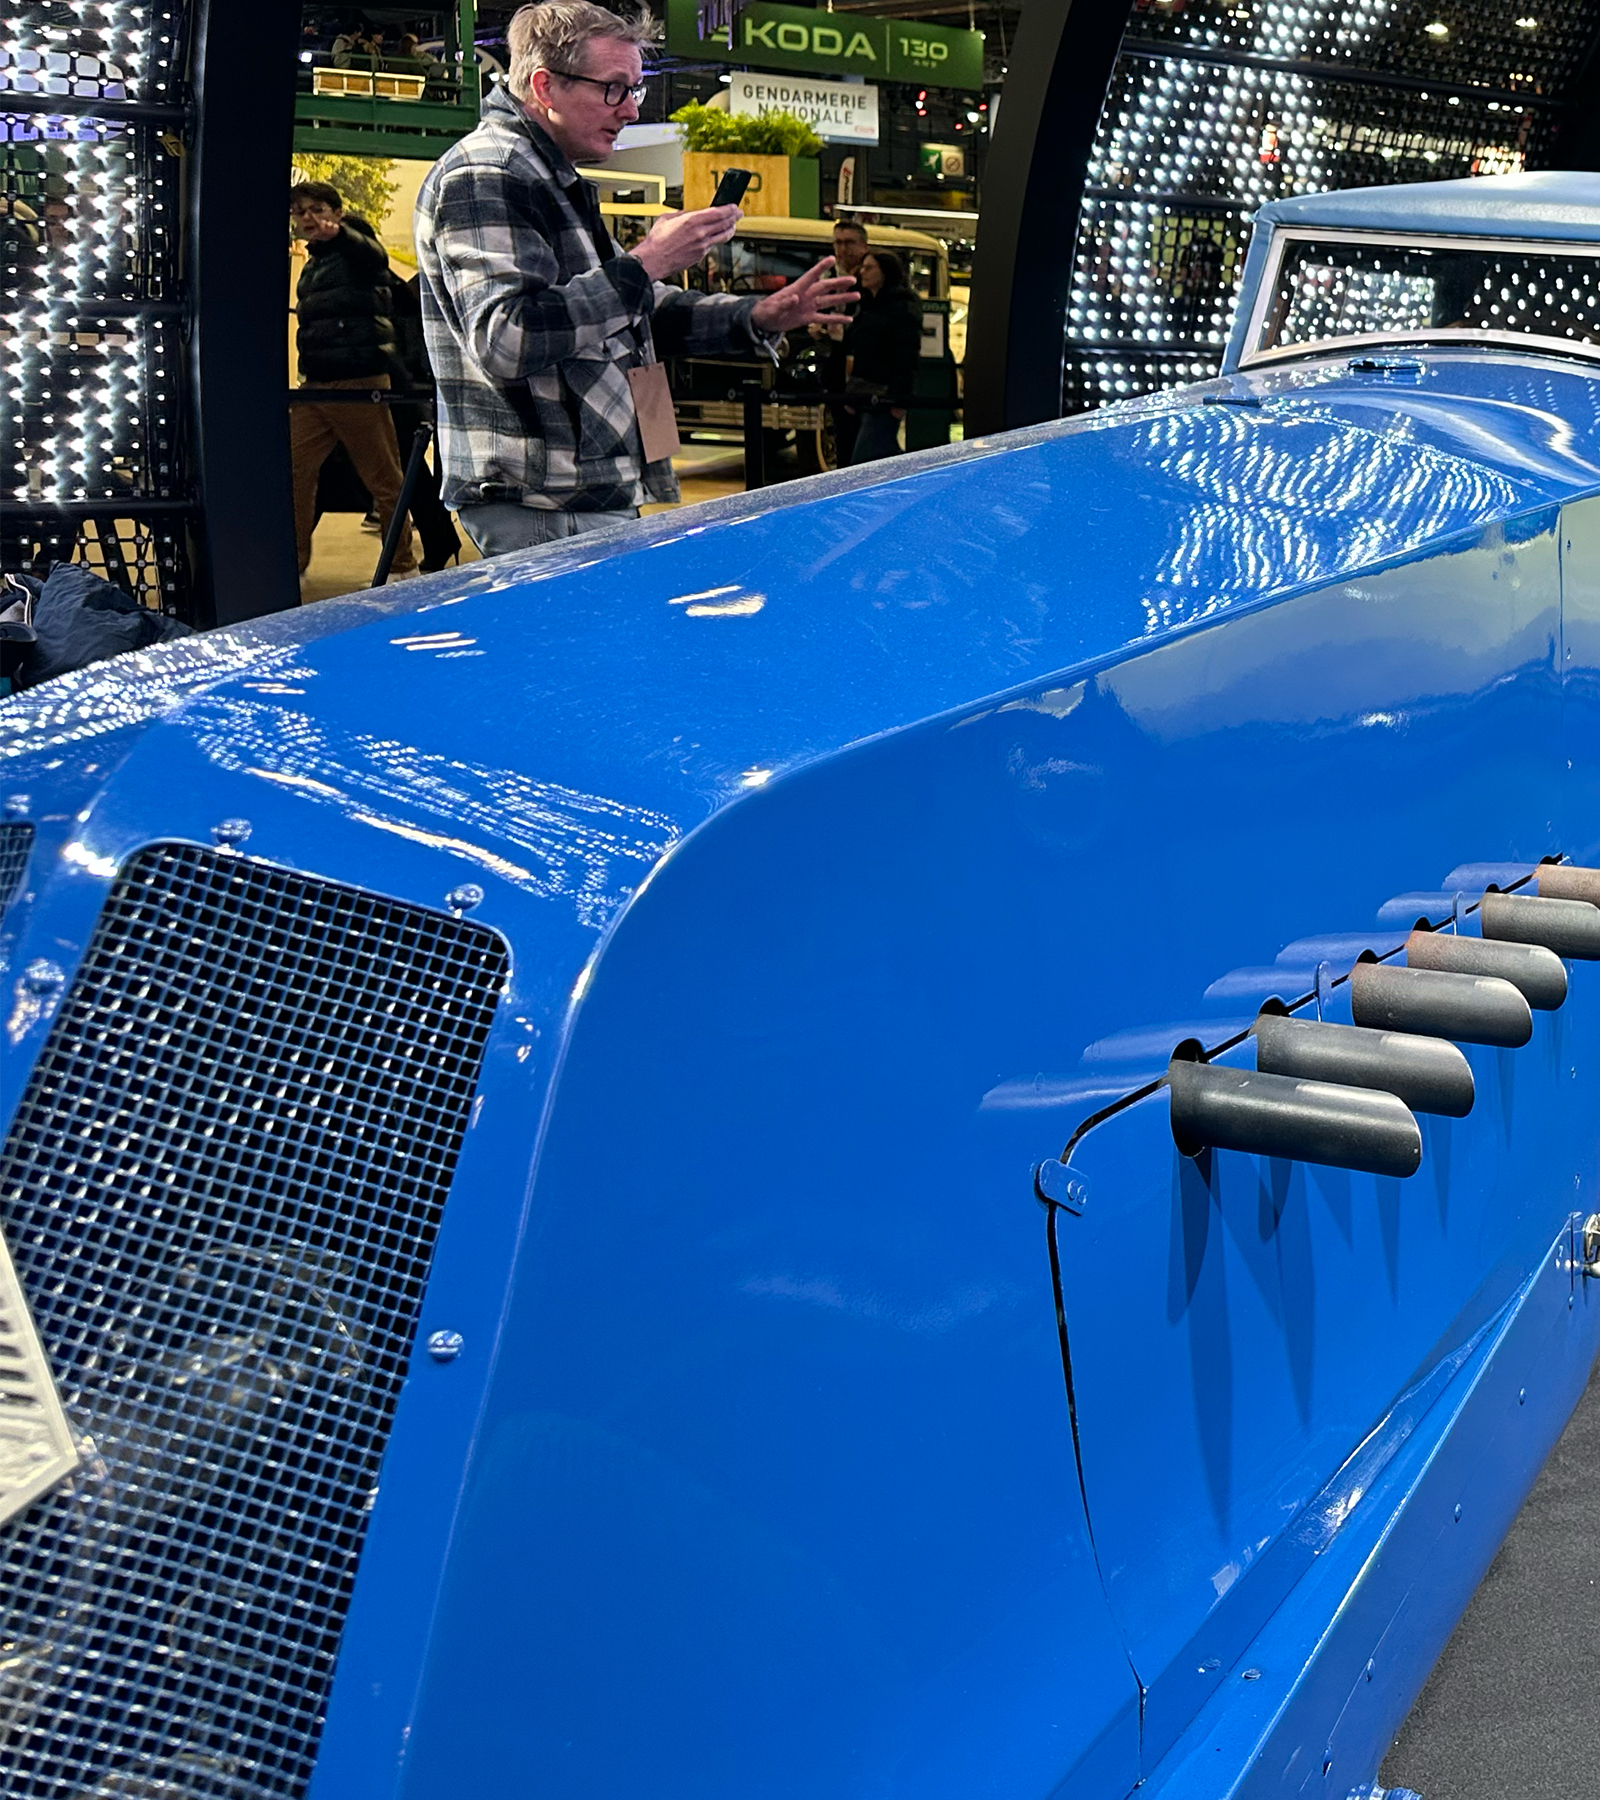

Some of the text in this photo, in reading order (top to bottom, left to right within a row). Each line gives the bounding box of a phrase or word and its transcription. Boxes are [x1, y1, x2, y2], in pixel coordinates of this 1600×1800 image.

[899, 37, 948, 61] 130
[743, 84, 867, 110] GENDARMERIE
[710, 169, 763, 193] 10
